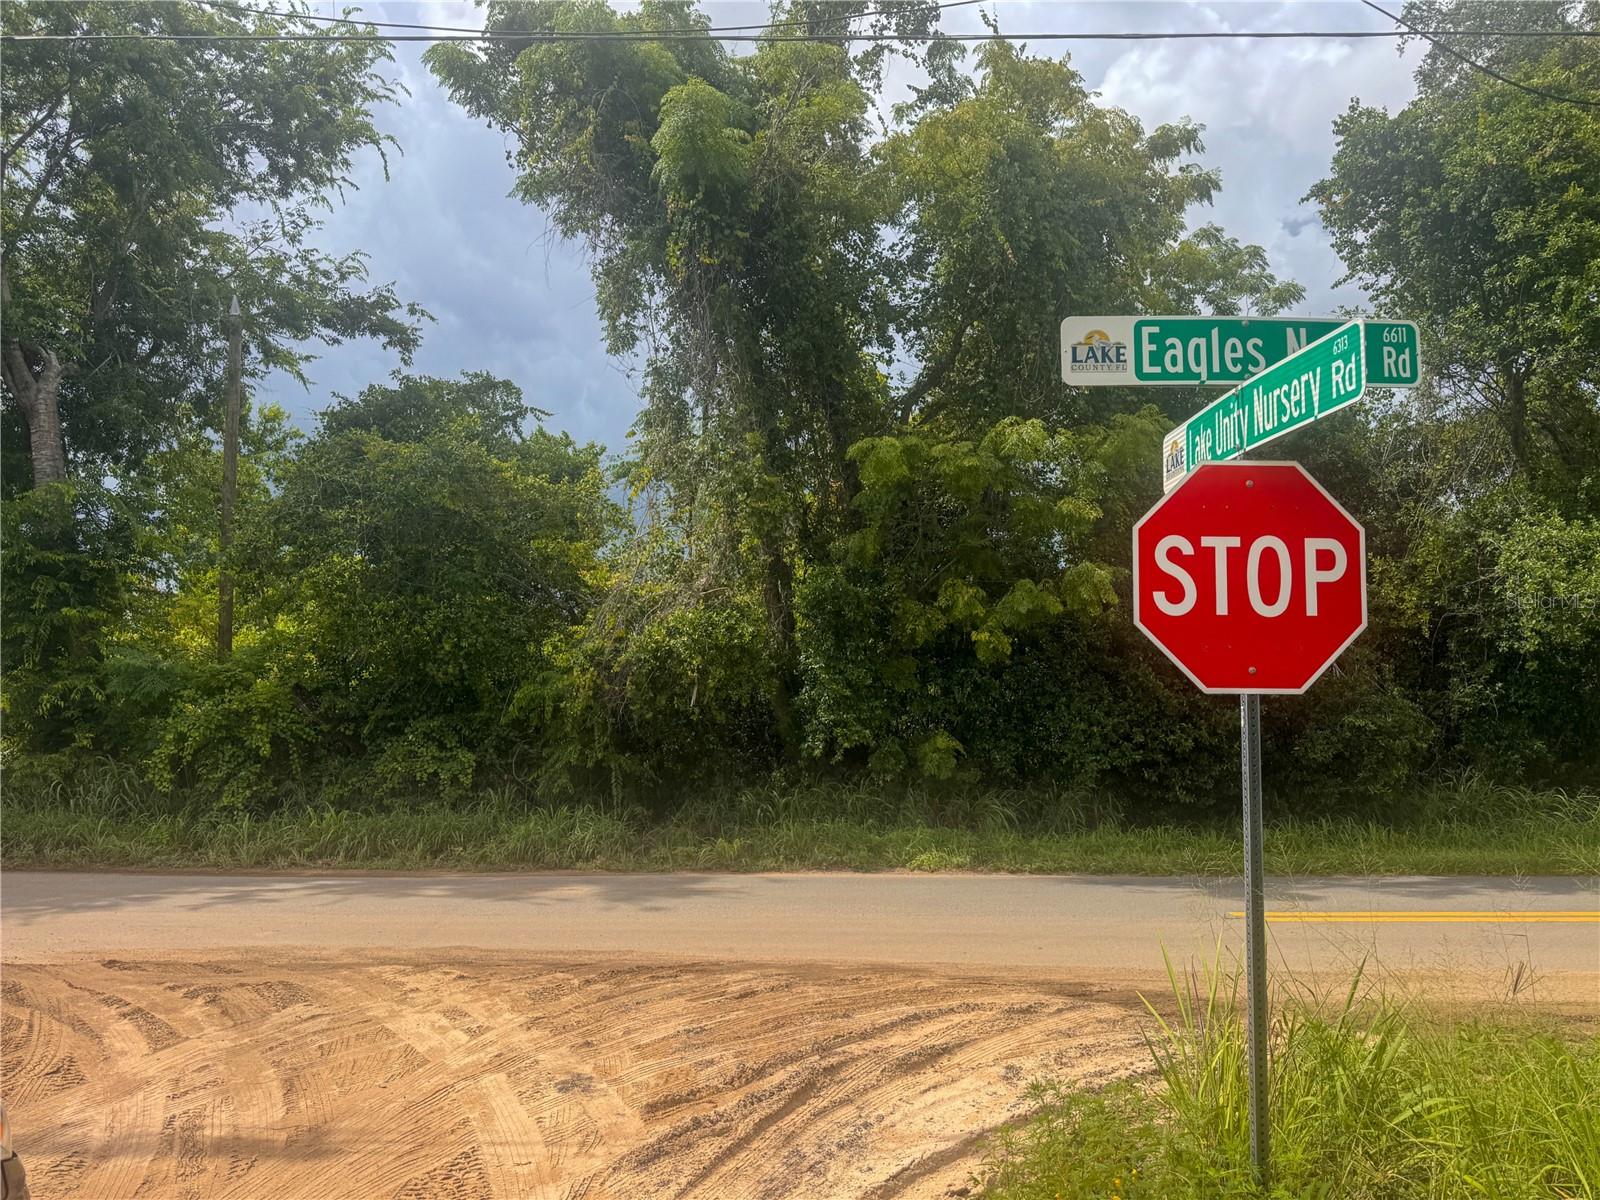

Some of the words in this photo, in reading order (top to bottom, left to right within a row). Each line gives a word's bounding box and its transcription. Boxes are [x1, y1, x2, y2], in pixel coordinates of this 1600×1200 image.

[1333, 334, 1348, 355] 6313
[1383, 327, 1407, 343] 6611
[1071, 345, 1127, 364] LAKE
[1141, 326, 1266, 382] Eagles
[1383, 346, 1411, 377] Rd
[1189, 423, 1212, 468] Lake
[1215, 400, 1249, 452] Unity
[1253, 366, 1321, 437] Nursery
[1331, 352, 1357, 399] Rd
[1166, 447, 1185, 473] LAKE
[1152, 535, 1348, 617] STOP
